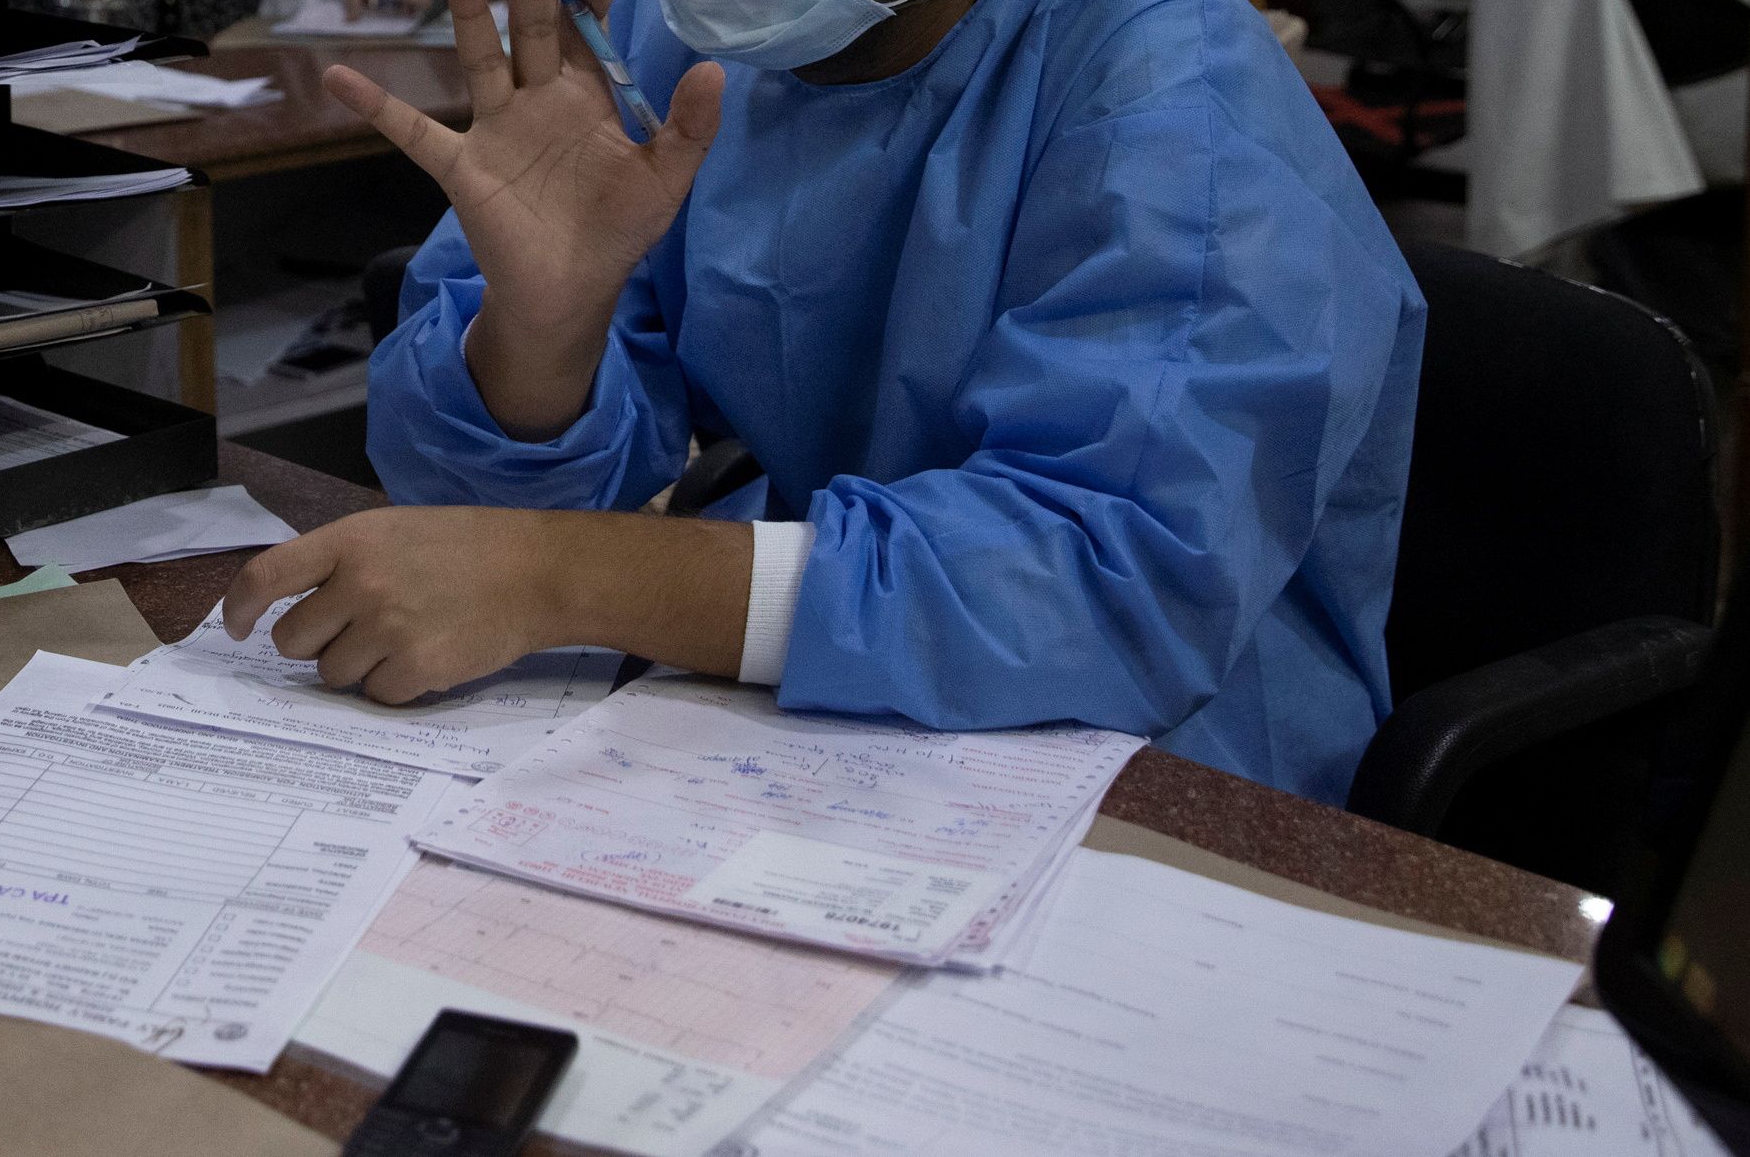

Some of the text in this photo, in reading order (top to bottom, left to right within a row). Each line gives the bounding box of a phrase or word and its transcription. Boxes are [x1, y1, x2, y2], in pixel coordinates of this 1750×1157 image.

[23, 730, 89, 747] INVESTIGATION
[107, 748, 168, 763] EXAMINATION
[67, 758, 136, 776] INVESTIGATION
[275, 777, 296, 785] FOR
[298, 780, 371, 799] AUTHORIZATION
[211, 786, 256, 799] RELIEVED
[280, 797, 314, 807] CURED
[25, 887, 75, 906] TPA
[820, 909, 904, 934] 1974078
